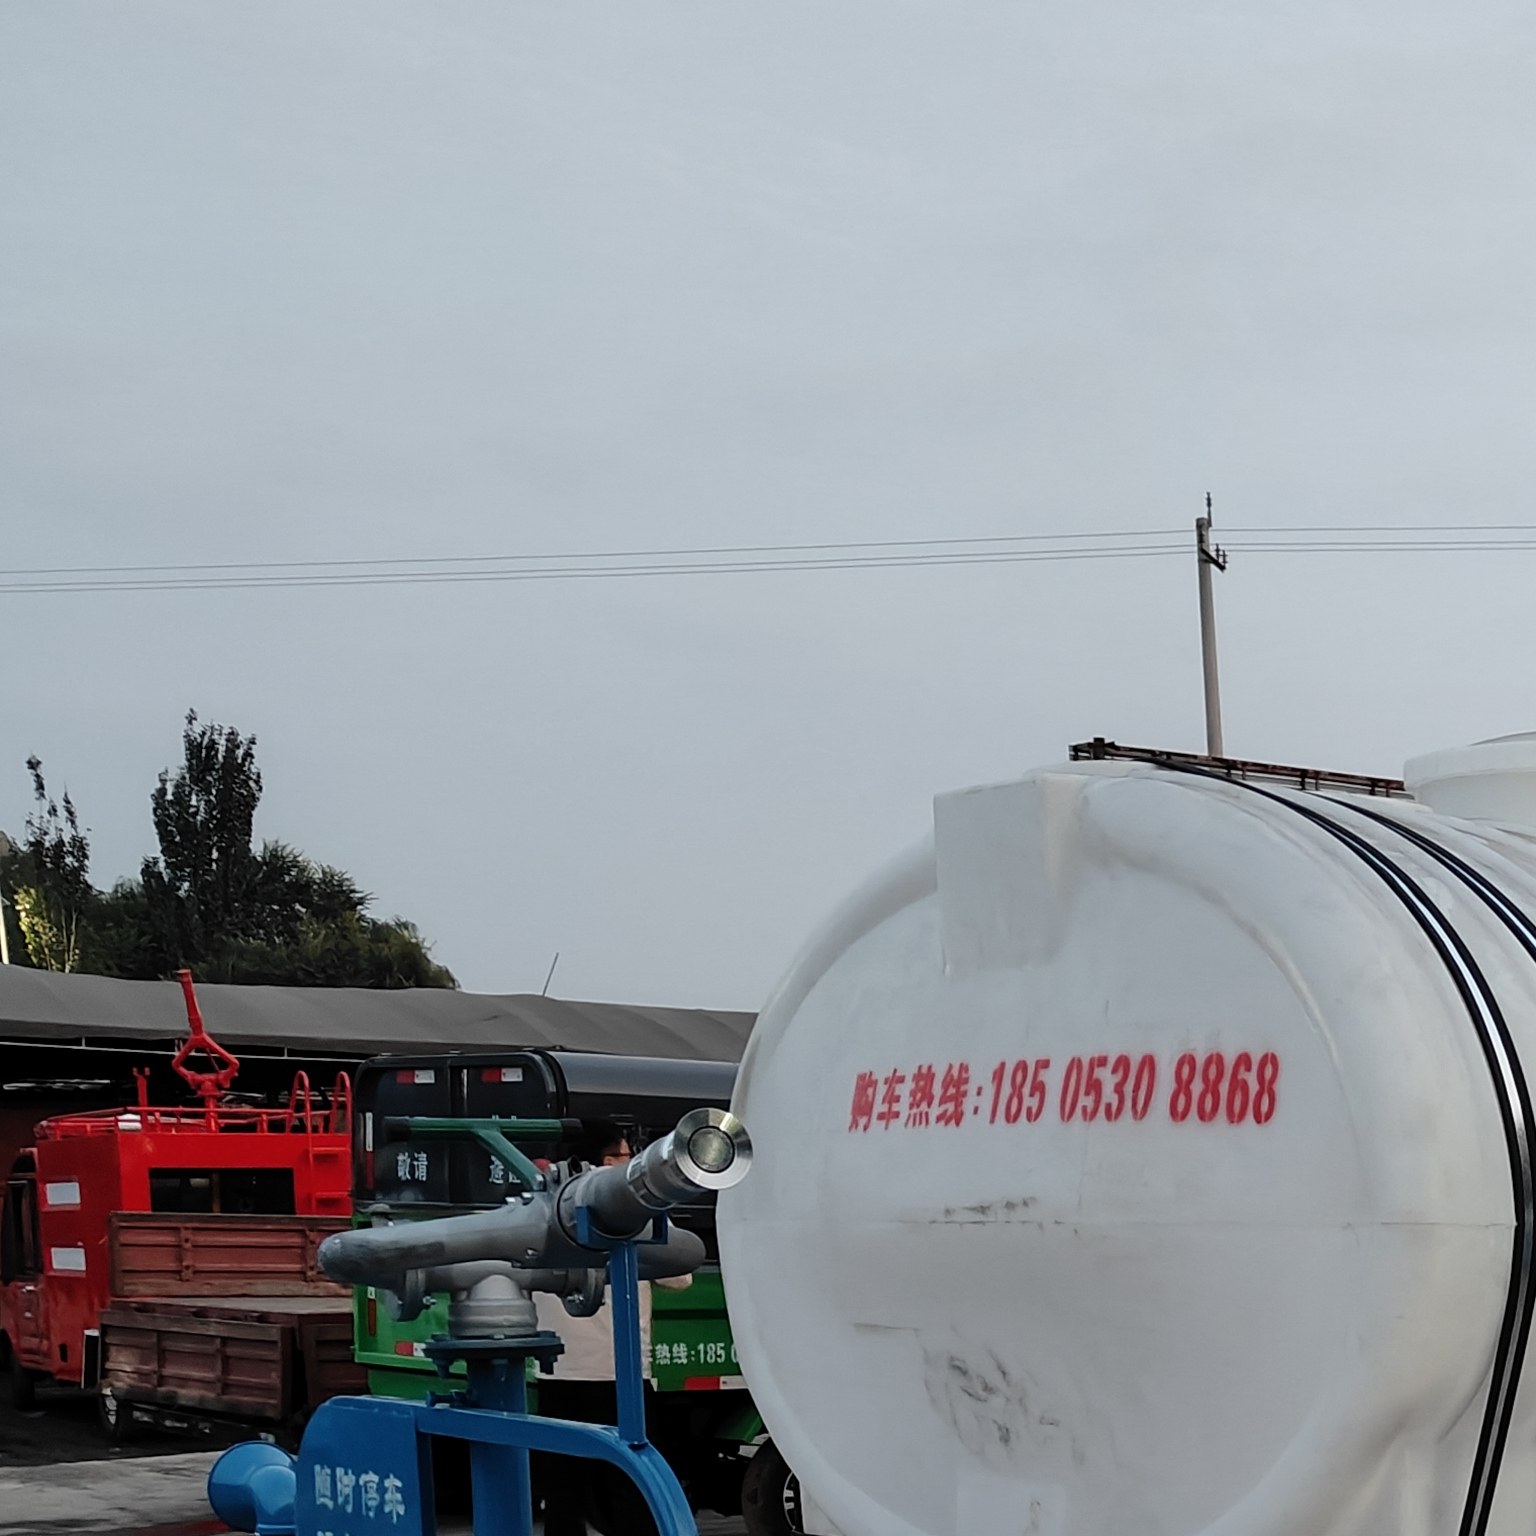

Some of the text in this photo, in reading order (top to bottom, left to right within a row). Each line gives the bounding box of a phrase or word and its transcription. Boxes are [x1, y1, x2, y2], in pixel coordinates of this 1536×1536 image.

[848, 1050, 1281, 1133] 购车热线:185 0530 8868
[396, 1151, 429, 1182] 敬请
[648, 1342, 726, 1365] 热线:185
